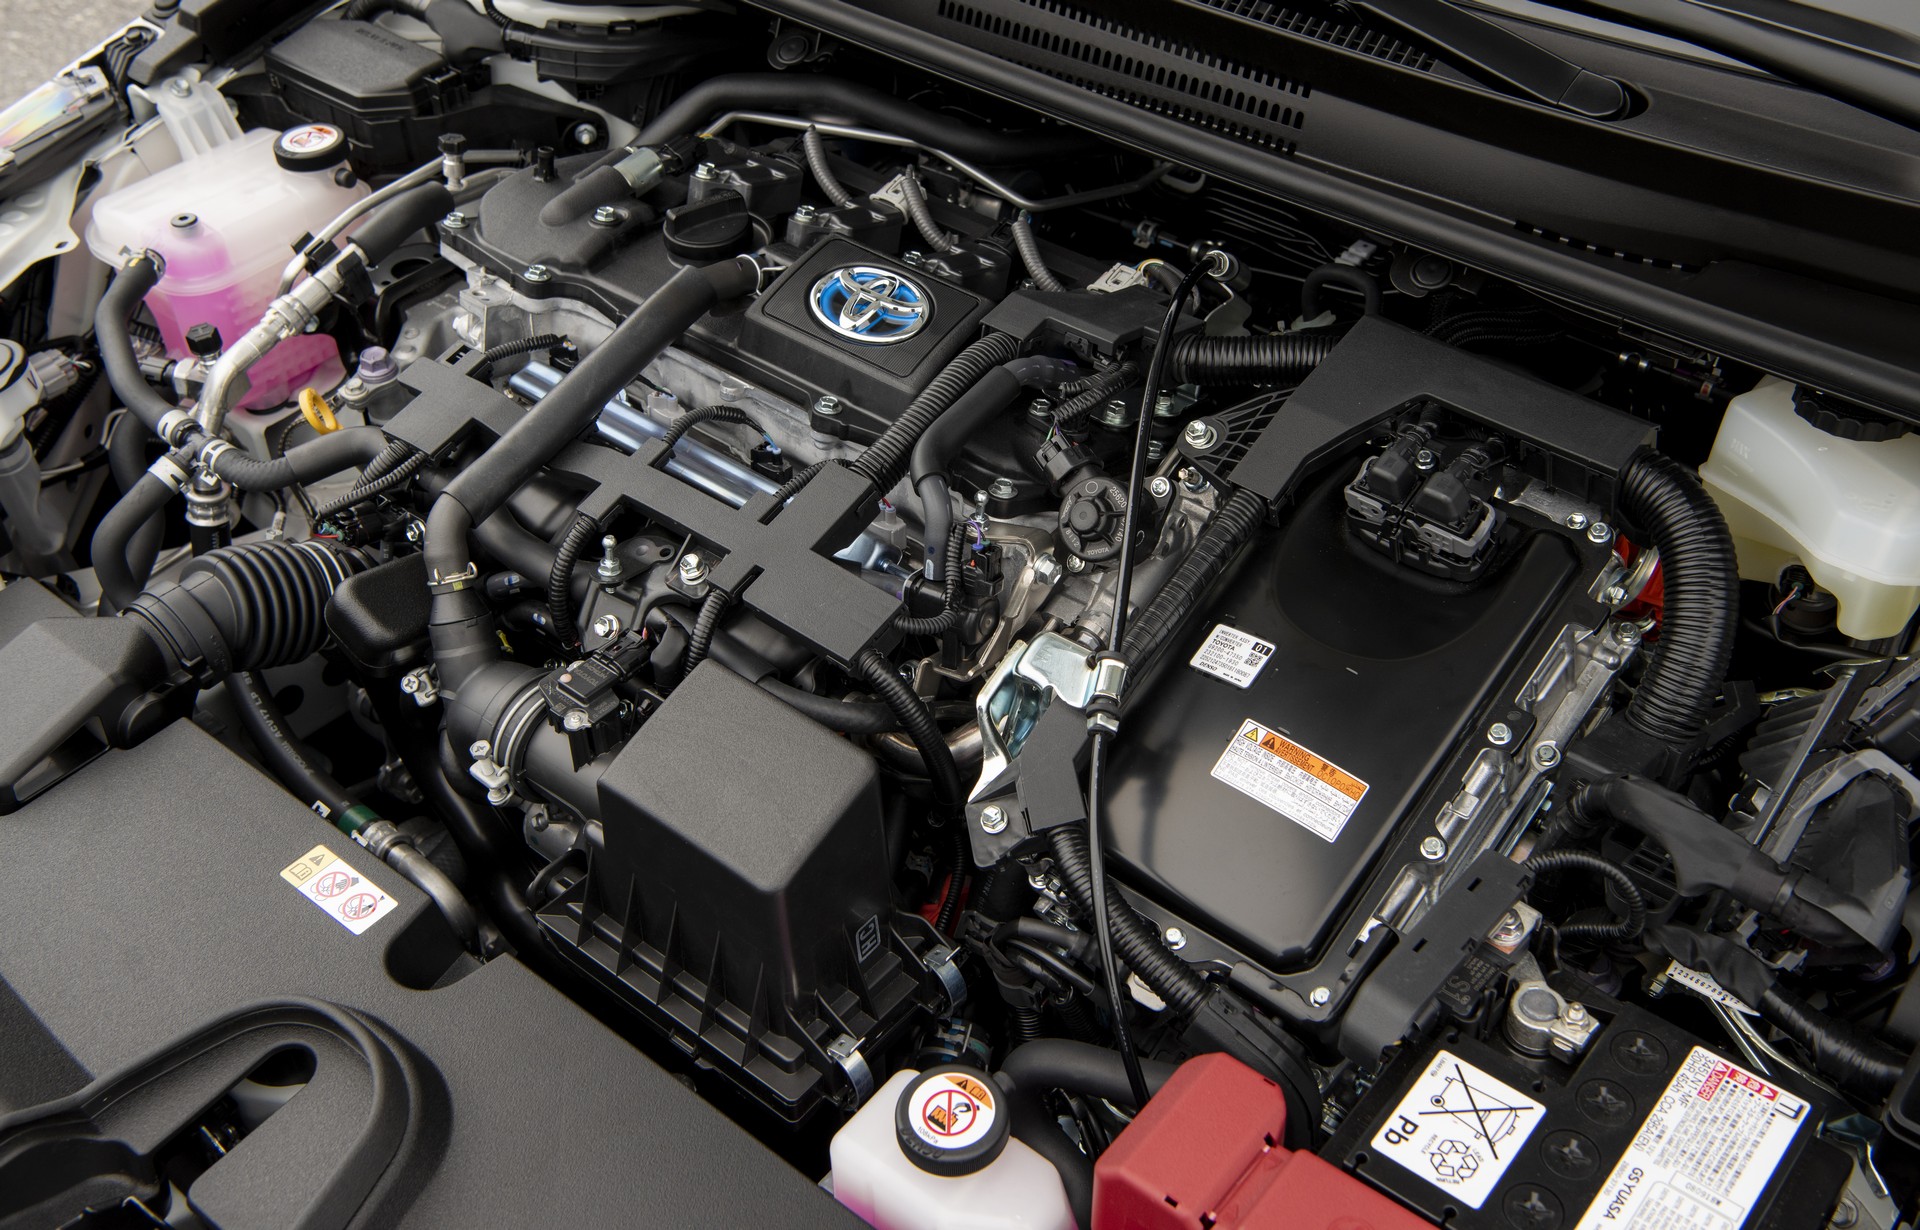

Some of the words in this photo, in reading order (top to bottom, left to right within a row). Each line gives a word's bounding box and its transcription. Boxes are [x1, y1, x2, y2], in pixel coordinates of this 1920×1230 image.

[1109, 486, 1127, 508] 25620
[1086, 547, 1109, 555] TOYOTA
[1211, 638, 1236, 650] TOYOTA
[1218, 629, 1238, 639] INVERTER
[1254, 644, 1267, 653] 01
[572, 667, 599, 686] TOYOTA
[1198, 661, 1218, 671] DENSO
[250, 690, 262, 705] LP
[1235, 737, 1246, 746] HIGH
[1244, 742, 1262, 755] VOLTAGE
[1242, 750, 1259, 763] TENSION
[1278, 740, 1311, 761] WARNING
[1274, 746, 1314, 772] AVERTISSEMENT
[861, 922, 877, 957] HC
[1683, 1049, 1704, 1074] 20HR
[1669, 1071, 1690, 1095] 45Ah
[1676, 1054, 1715, 1109] 345LN1-MF
[1697, 1069, 1722, 1100] DANGER
[1656, 1094, 1675, 1116] CCA
[1382, 1112, 1419, 1151] Pb
[1632, 1112, 1664, 1153] 295A(EN)
[898, 1126, 946, 1160] DENSO
[1420, 1131, 1438, 1156] RECYCLE
[1602, 1179, 1635, 1222] YUASA
